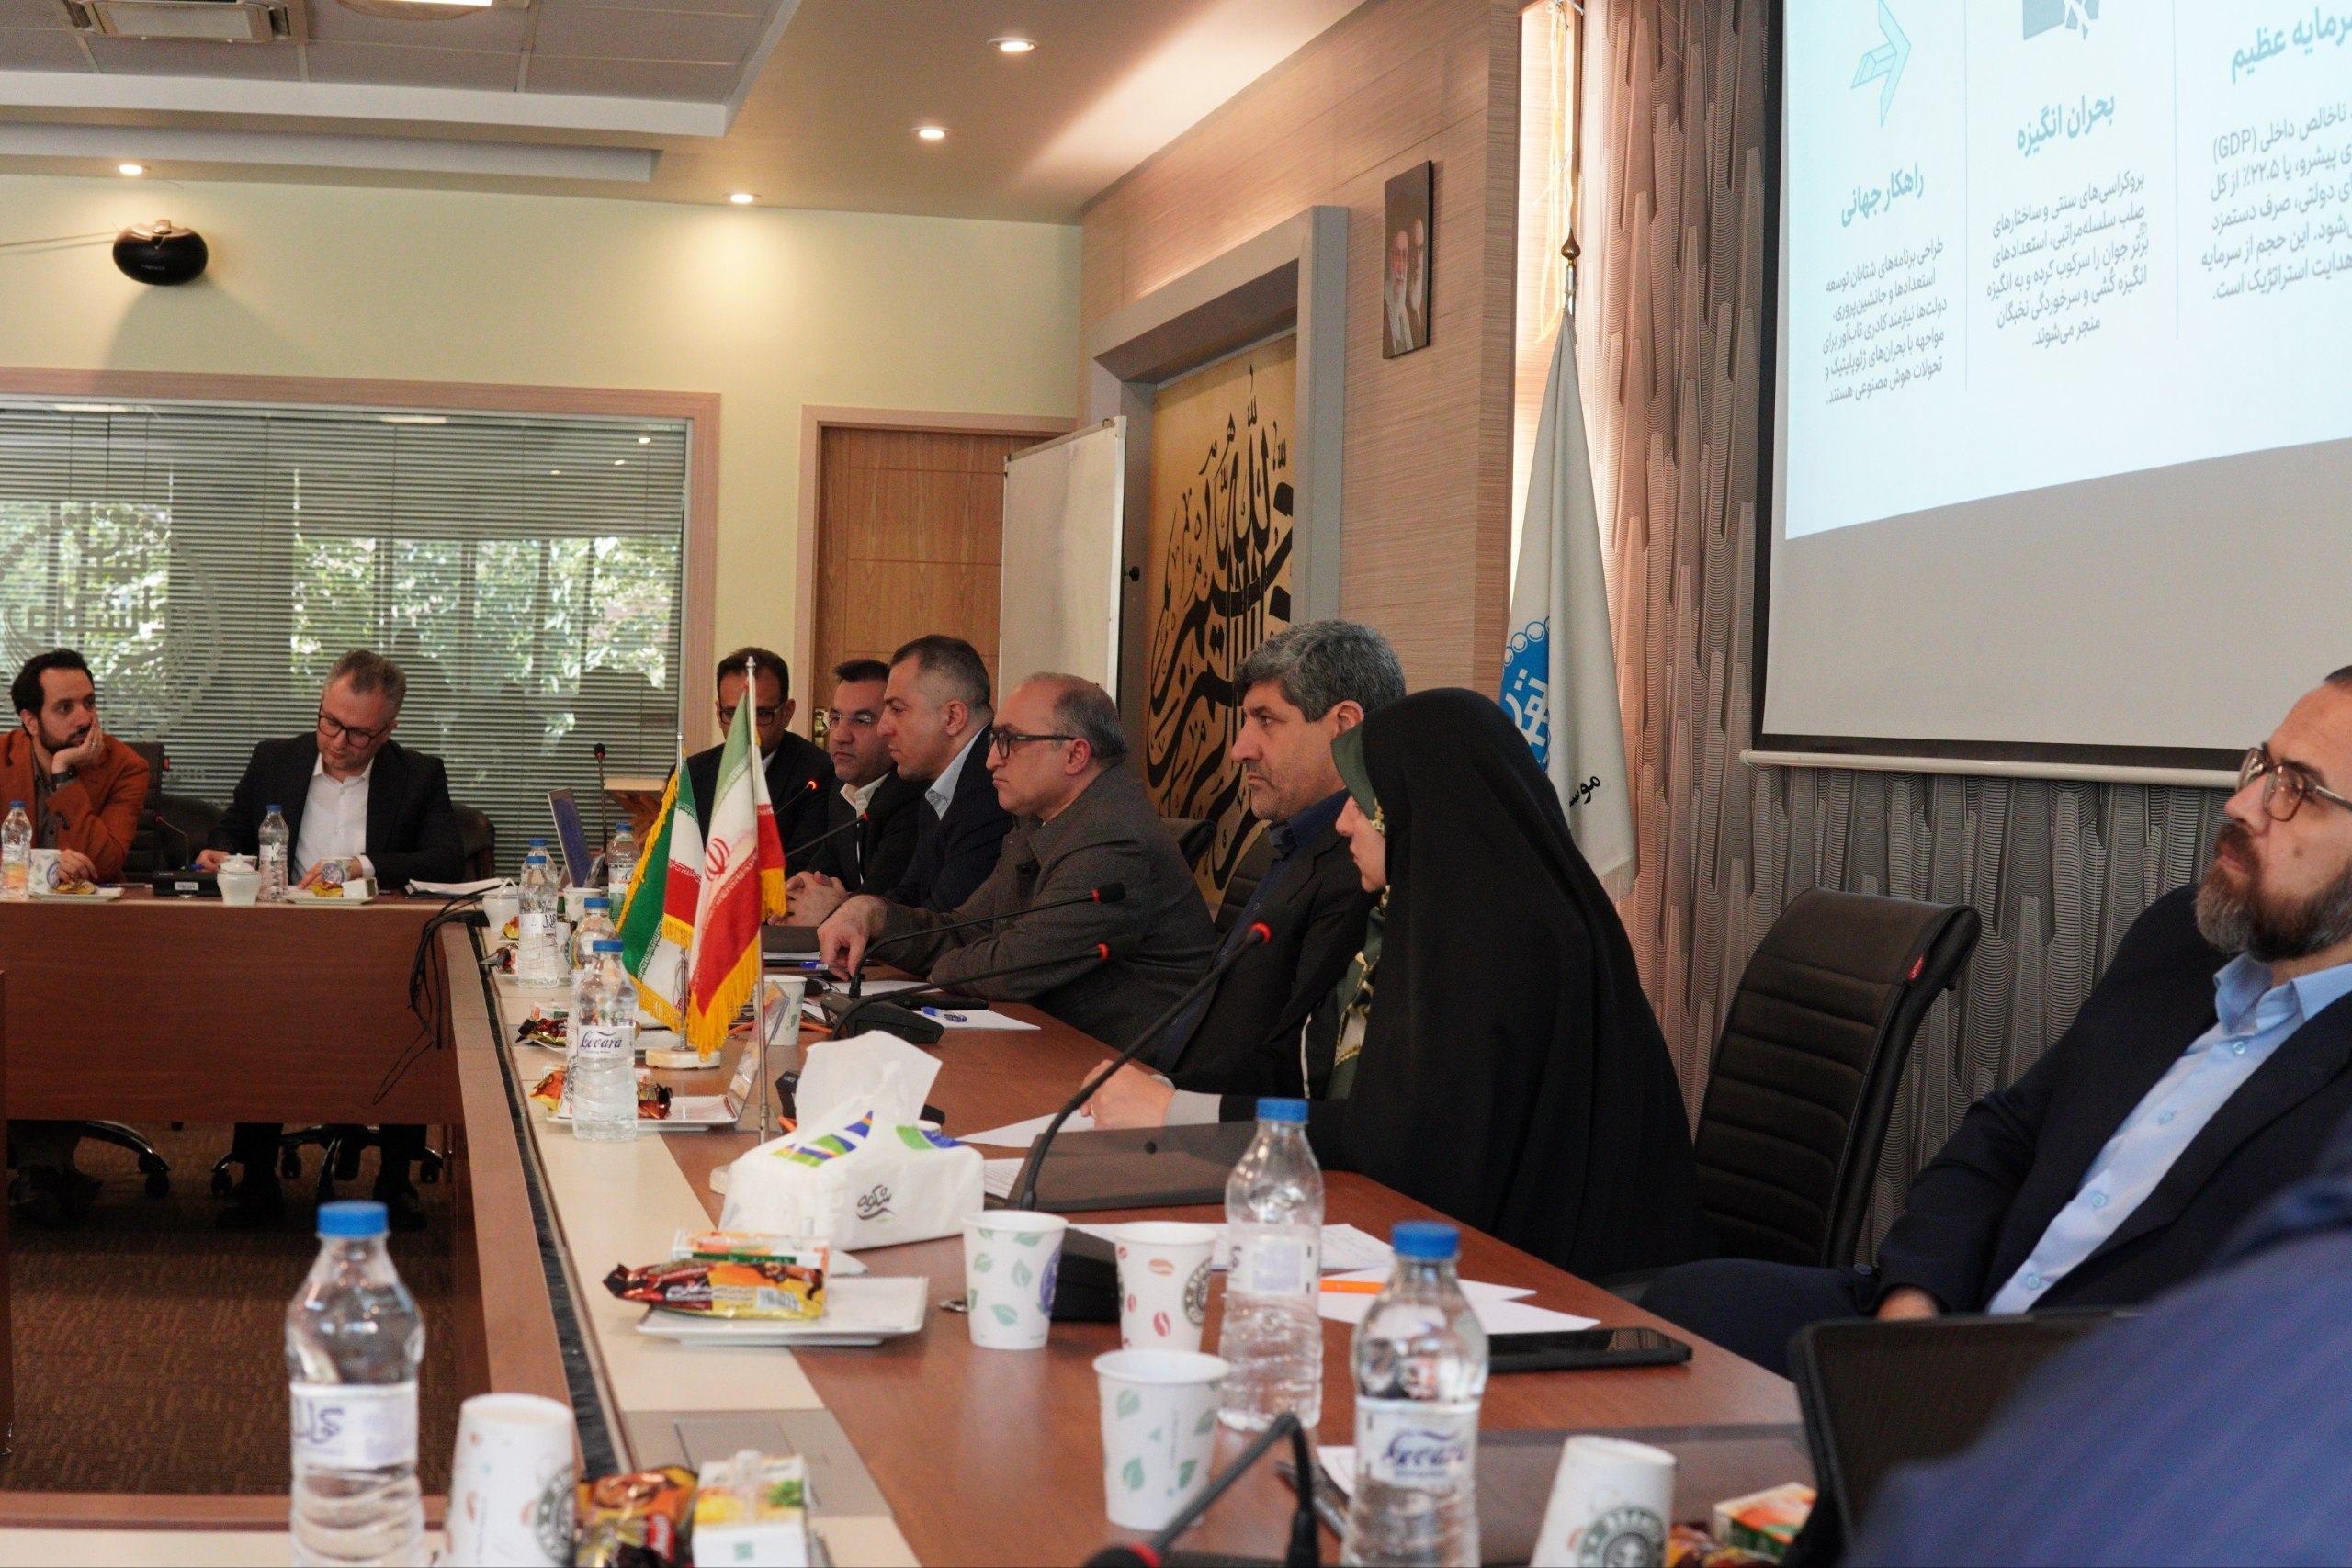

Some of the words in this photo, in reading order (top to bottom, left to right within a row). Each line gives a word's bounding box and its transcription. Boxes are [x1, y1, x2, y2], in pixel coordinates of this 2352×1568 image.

[2292, 5, 2352, 55] رمایه
[2232, 27, 2287, 85] عظیم
[2018, 104, 2063, 158] انگیزه
[2067, 94, 2115, 140] بحران
[2299, 102, 2346, 141] ناخالص
[2212, 125, 2256, 166] (GDP)
[2260, 118, 2295, 153] داخلی
[2282, 153, 2292, 182] یا
[2295, 145, 2336, 177] پیشرو،
[1883, 162, 1924, 212] راهکار
[2211, 172, 2227, 202] کل
[2230, 168, 2239, 198] از
[2295, 182, 2335, 213] دولتی،
[1841, 185, 1882, 228] جهانی
[1993, 203, 2041, 239] ساختارهای
[2042, 205, 2049, 222] و
[2051, 195, 2077, 220] سنتی
[2119, 200, 2145, 230] صلب
[2211, 206, 2256, 236] دستمزد
[2259, 193, 2291, 221] صرف
[1917, 235, 1944, 265] طراحی
[1992, 230, 2048, 269] استعدادهای
[2244, 234, 2253, 265] از
[2256, 235, 2287, 264] حجم
[2290, 220, 2309, 253] این
[2056, 252, 2091, 280] سرکوب
[2093, 246, 2099, 270] را
[2102, 240, 2128, 266] جوان
[2201, 244, 2242, 272] سرمایه
[1826, 271, 1849, 293] توسعه
[1850, 260, 1876, 288] شتابان
[1894, 266, 1936, 297] استعدادها
[1986, 271, 2012, 301] انگیزه
[2014, 276, 2023, 292] به
[2026, 274, 2031, 291] و
[2034, 259, 2054, 286] کرده
[2118, 264, 2147, 296] انگیزه
[2212, 273, 2244, 299] است.
[2248, 257, 2309, 295] استراتژیک
[1888, 288, 1894, 305] و
[2031, 288, 2080, 321] سرخوردگی
[2083, 288, 2089, 306] و
[1864, 312, 1887, 340] کادری
[1888, 304, 1915, 330] نیازمند
[1996, 299, 2029, 329] نخبگان
[2076, 315, 2101, 341] منجر
[1823, 331, 1838, 355] برای
[1907, 333, 1913, 355] با
[1915, 326, 1944, 353] مواجهه
[1825, 367, 1829, 383] و
[1890, 367, 1912, 391] هوش
[1913, 355, 1943, 381] تحولات
[1855, 378, 1888, 400] مصنوعی
[856, 1183, 892, 1213] شکوه
